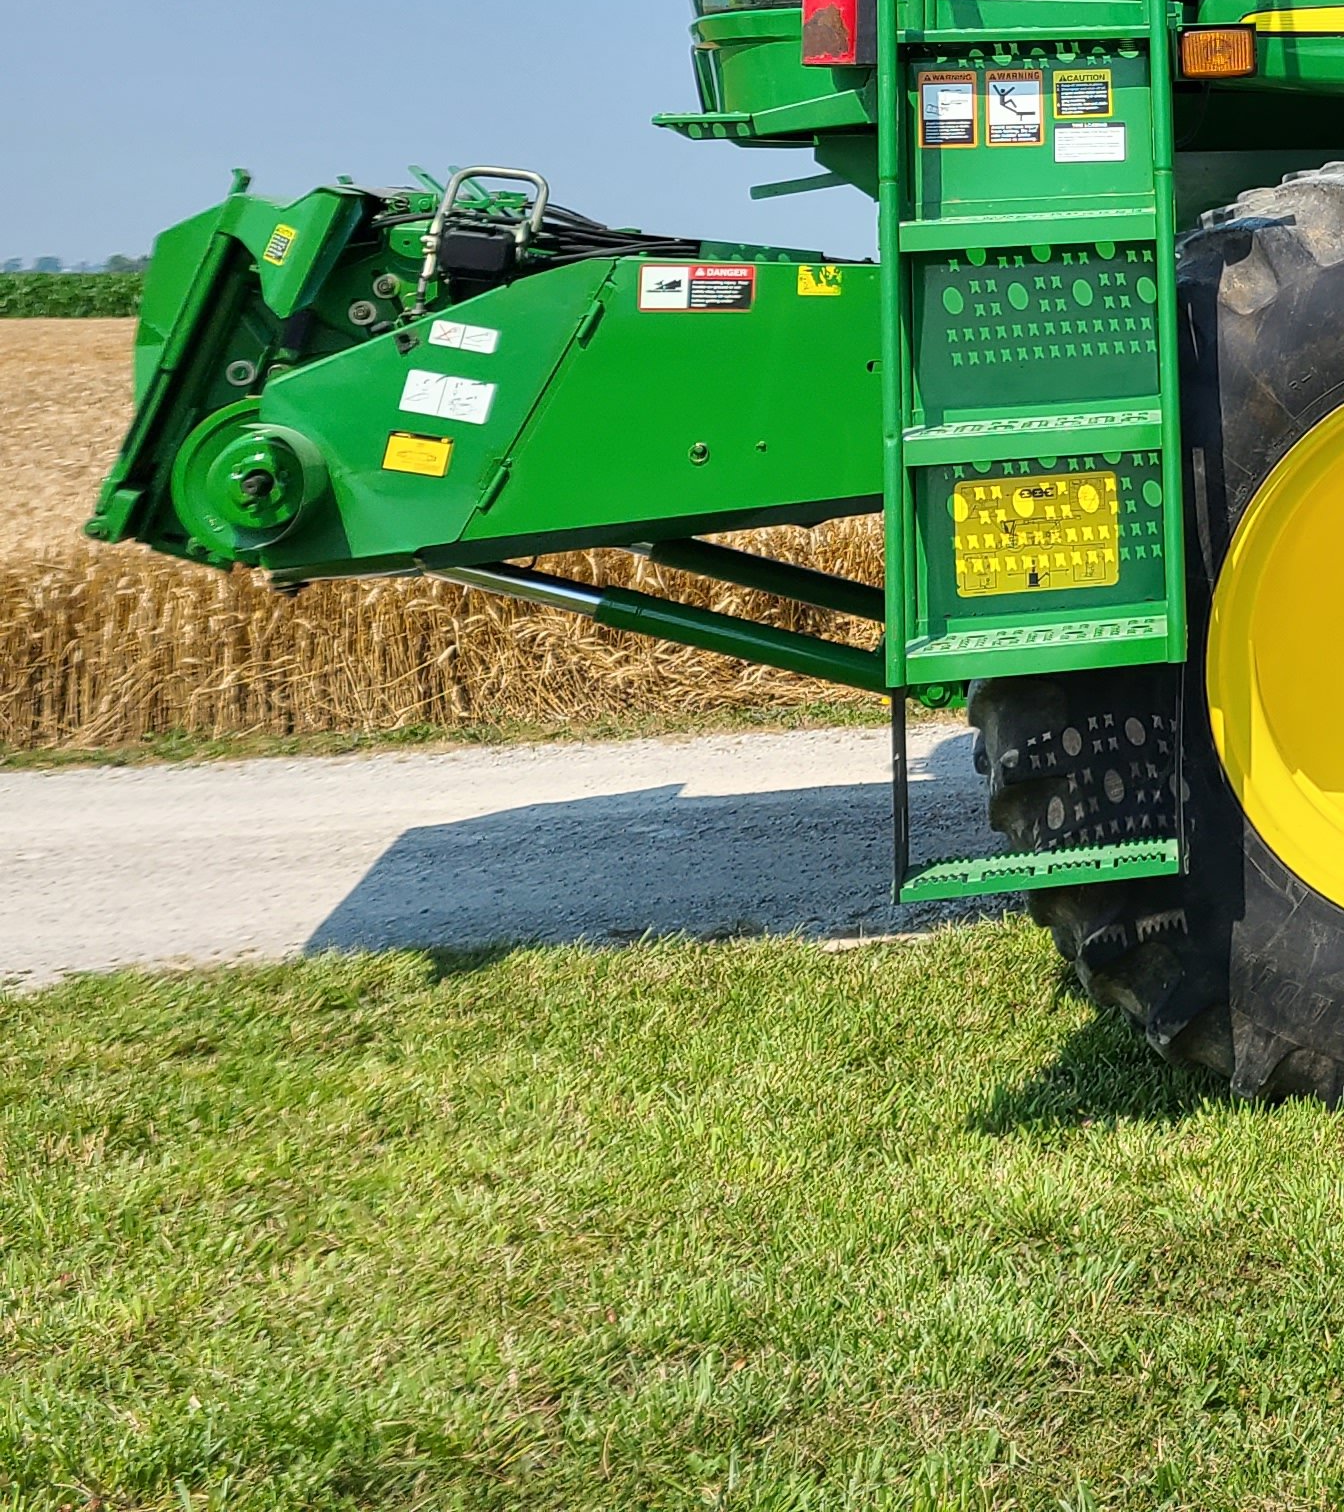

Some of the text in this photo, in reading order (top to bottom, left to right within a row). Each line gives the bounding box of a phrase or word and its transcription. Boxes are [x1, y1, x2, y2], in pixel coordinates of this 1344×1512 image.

[932, 73, 972, 81] WARNING
[996, 71, 1040, 80] WARNING
[1066, 74, 1106, 82] CAUTION
[706, 268, 748, 277] DANGER
